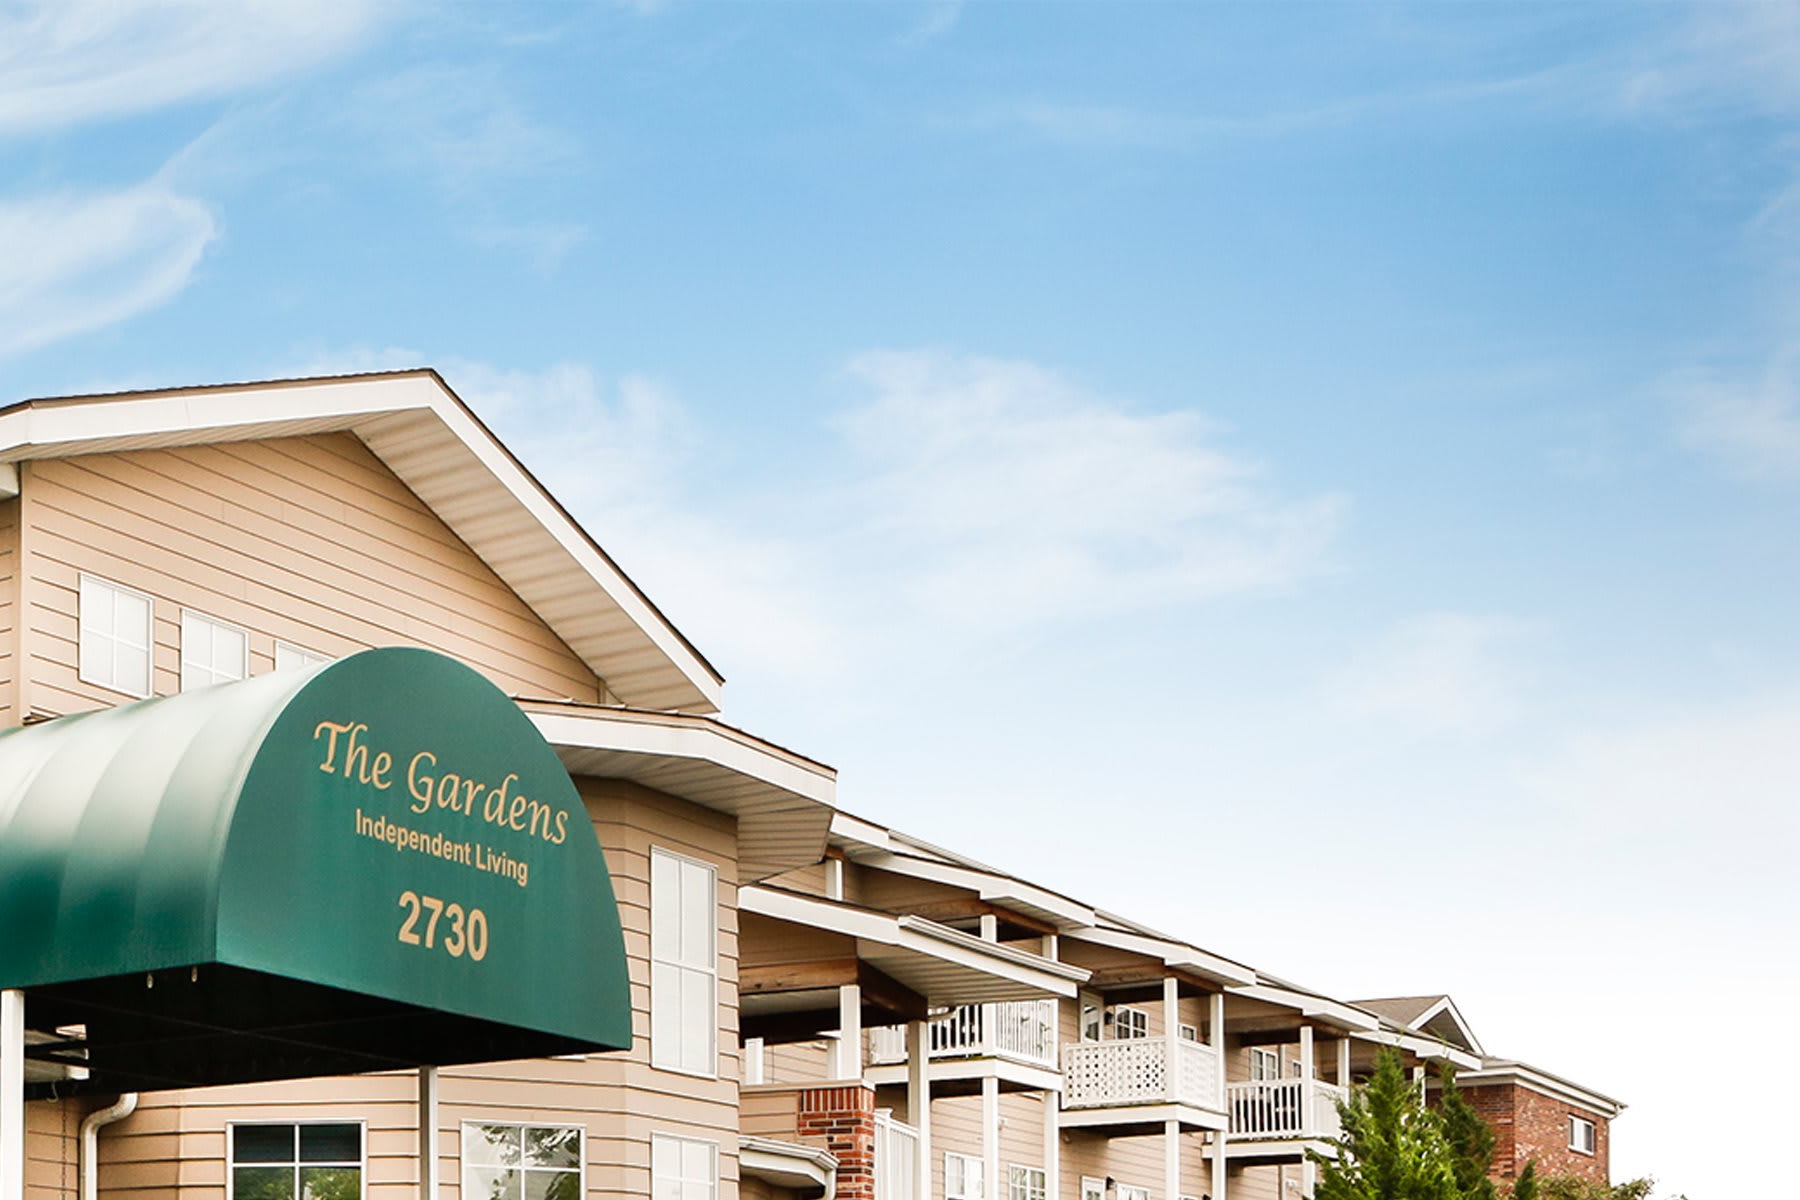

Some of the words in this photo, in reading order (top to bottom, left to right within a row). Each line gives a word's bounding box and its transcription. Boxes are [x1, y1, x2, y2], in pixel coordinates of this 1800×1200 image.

[313, 720, 393, 790] The
[407, 751, 569, 845] Gardens
[355, 808, 472, 867] Independent
[475, 846, 528, 887] Living
[398, 890, 489, 961] 2730
